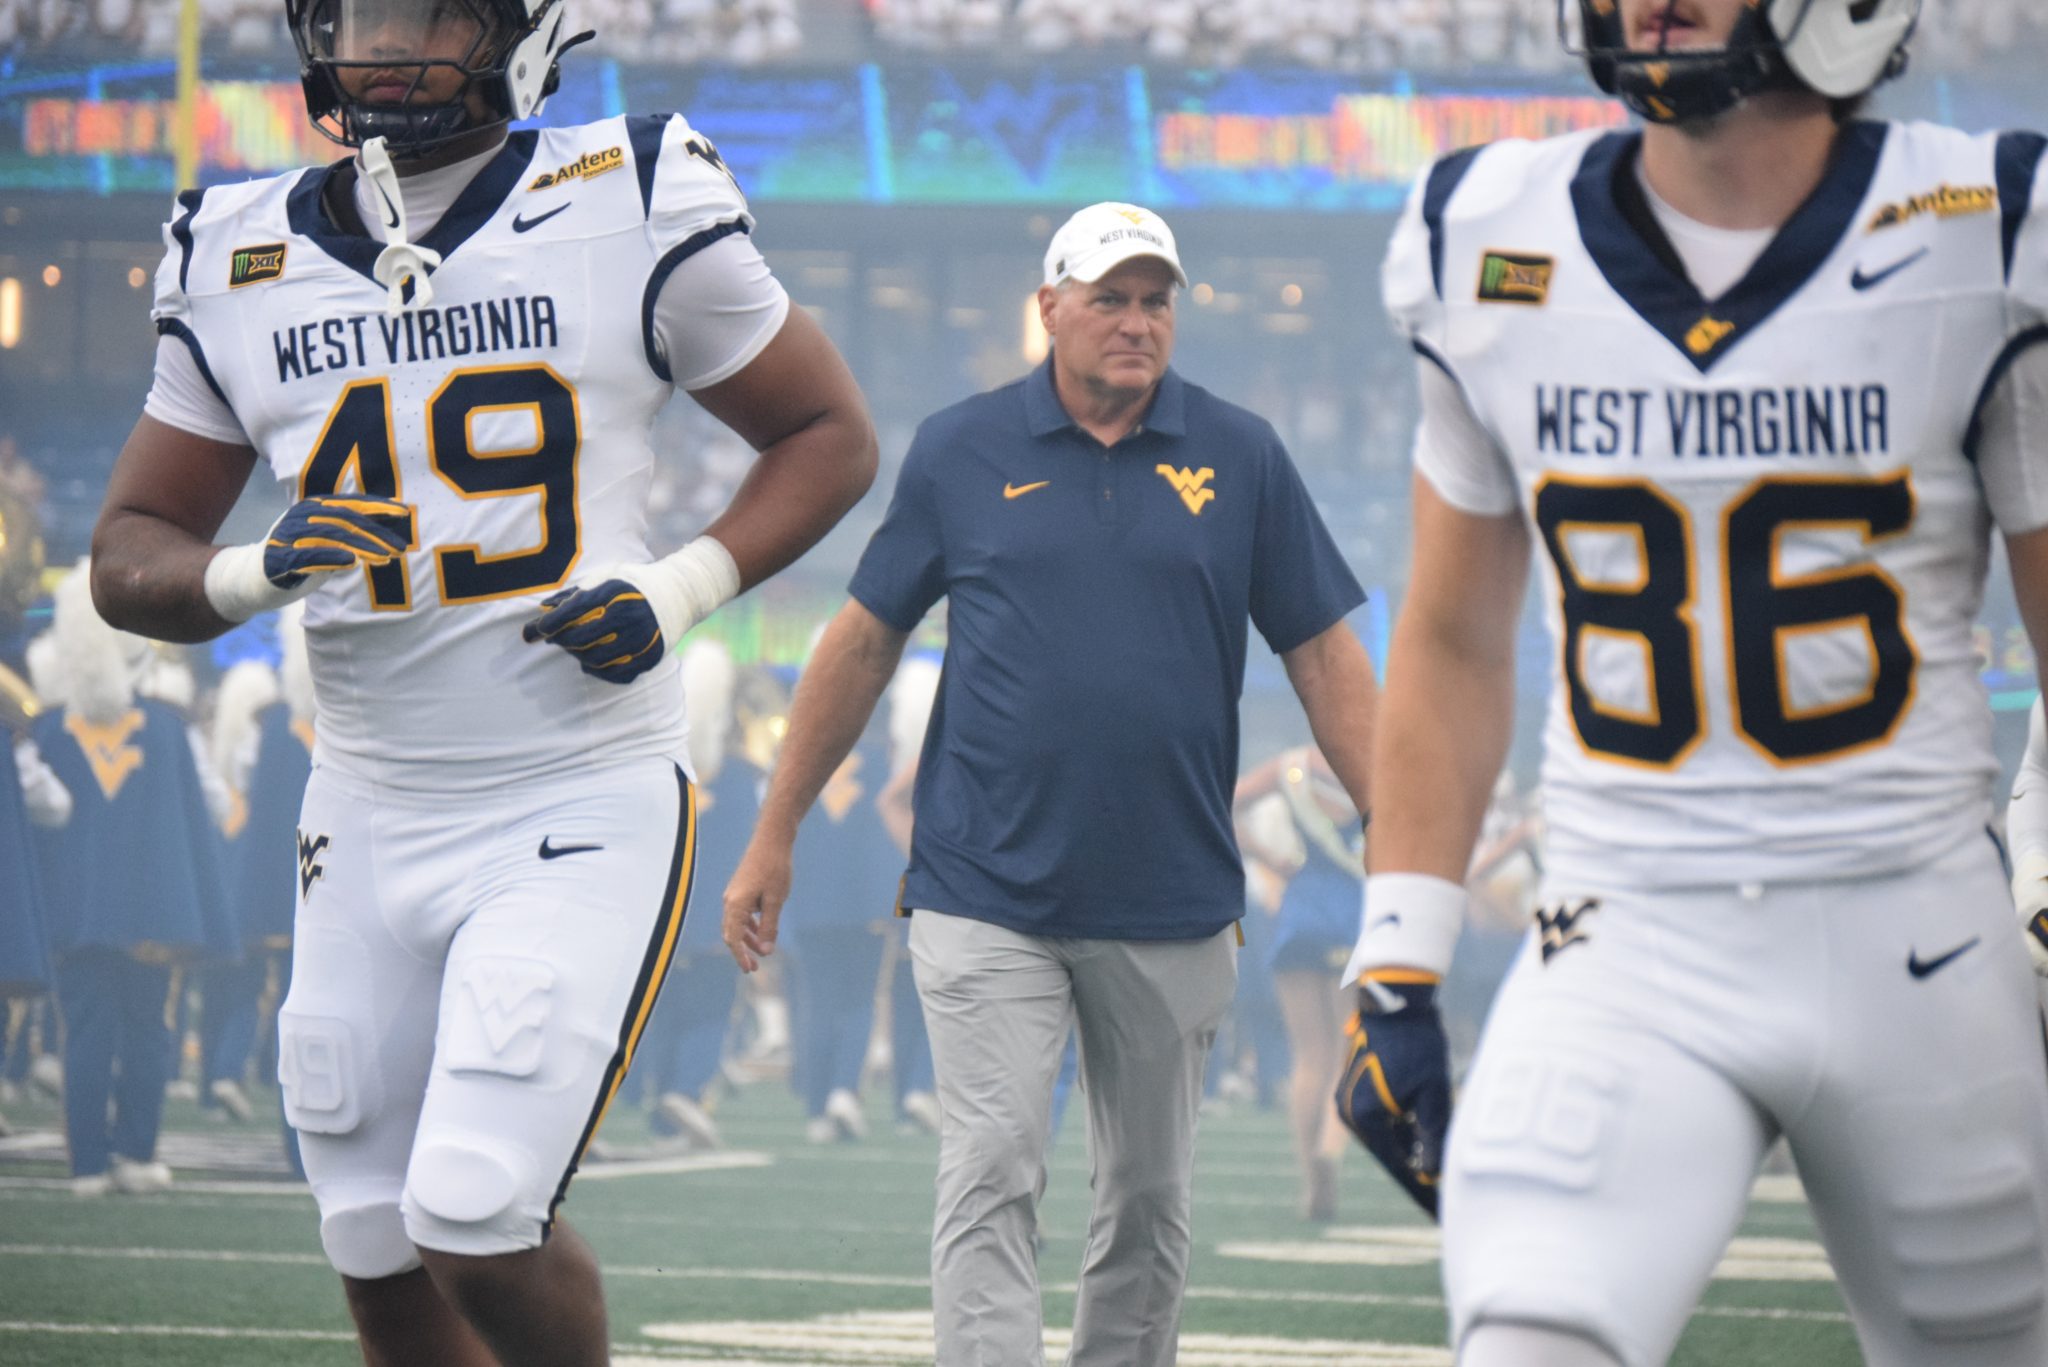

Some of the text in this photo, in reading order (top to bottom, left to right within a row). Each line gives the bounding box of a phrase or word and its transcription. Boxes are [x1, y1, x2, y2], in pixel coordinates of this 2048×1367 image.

[555, 146, 622, 184] Antero
[1099, 229, 1124, 246] WEST
[273, 296, 558, 383] WEST VIRGINIA
[1535, 383, 1889, 457] WEST VIRGINIA
[300, 361, 583, 612] 49
[1534, 466, 1921, 772] 86
